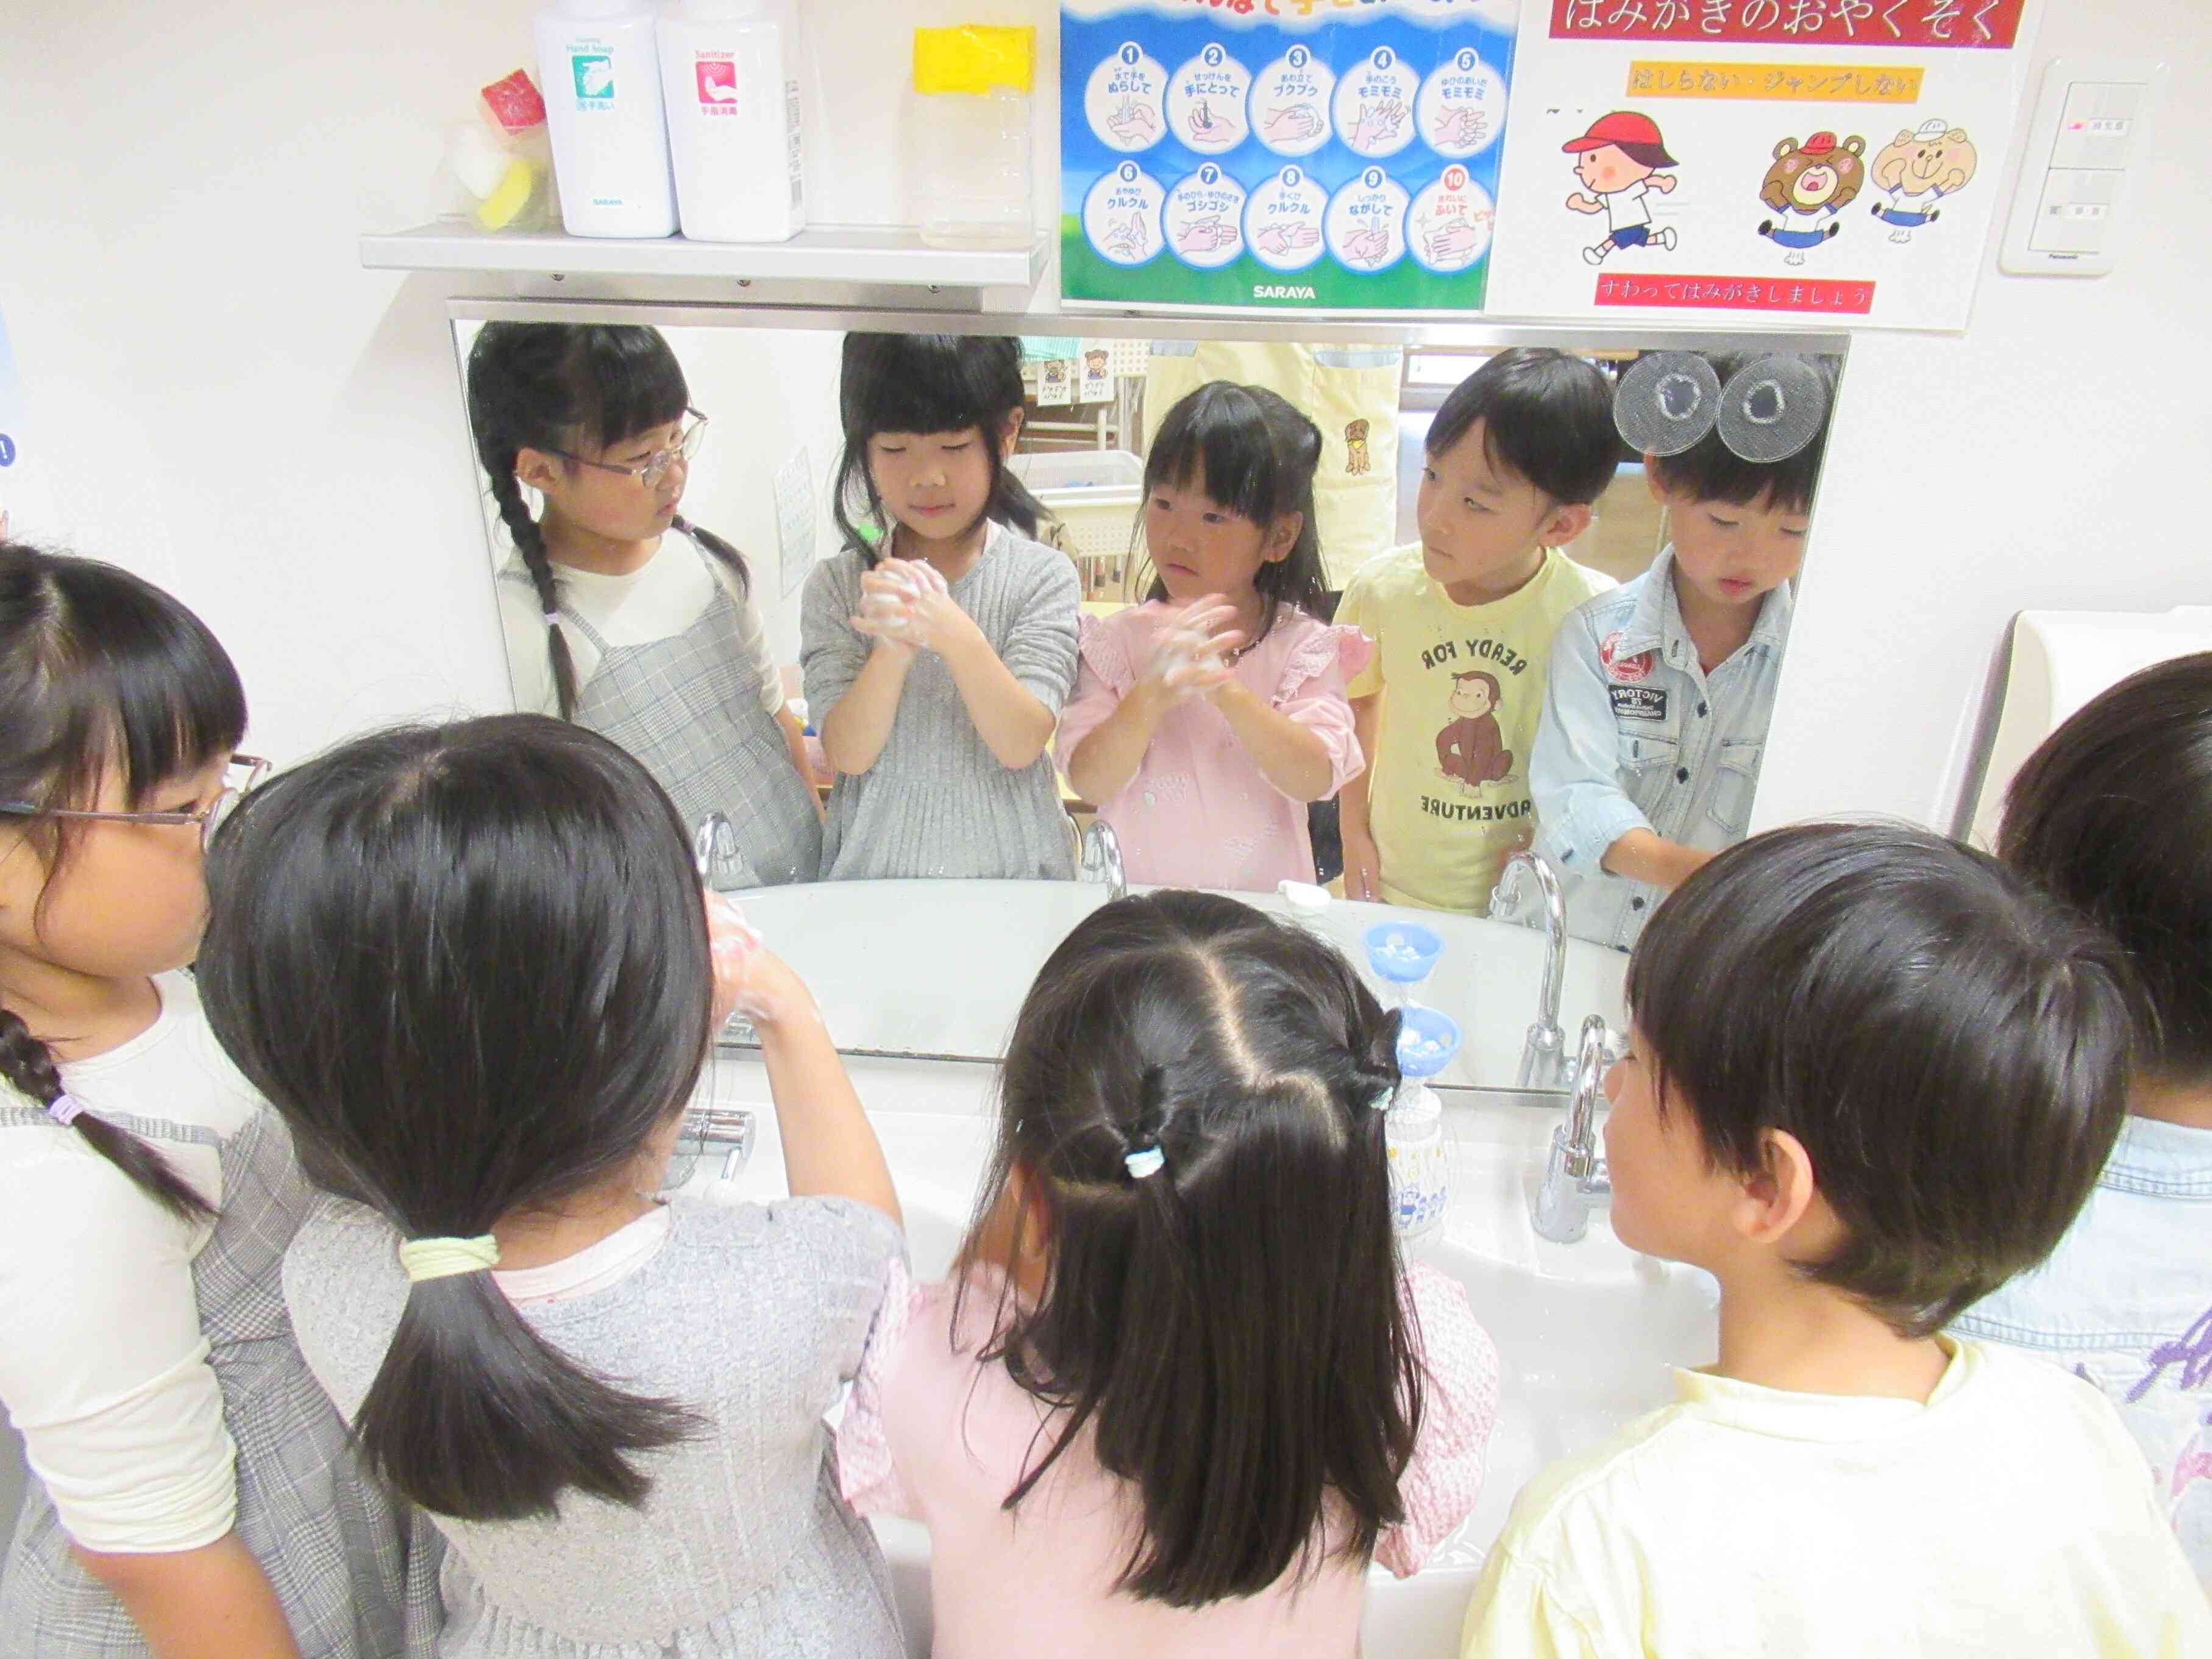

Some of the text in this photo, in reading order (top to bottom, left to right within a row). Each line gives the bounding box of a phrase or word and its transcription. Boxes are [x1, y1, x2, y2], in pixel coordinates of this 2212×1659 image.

[1565, 0, 1999, 40] はみがきのおやくそく
[695, 50, 734, 59] Sanitizer
[1194, 72, 1232, 82] せっけんを
[1632, 69, 1918, 96] はしらない・ジャンプしない
[1108, 80, 1152, 94] ぬらして
[1184, 82, 1240, 98] 手にとって
[1358, 86, 1403, 99] モミモミ
[1442, 87, 1485, 101] モミモミ
[1106, 197, 1149, 210] クルクル
[1357, 194, 1386, 203] しっかり
[1187, 201, 1230, 213] ゴシゴシ
[1267, 202, 1311, 215] クルクル
[1348, 204, 1395, 216] ながして
[1435, 204, 1468, 216] ふいて
[1253, 285, 1316, 299] SARAYA
[1601, 280, 1868, 305] すわってはみがきしましょう
